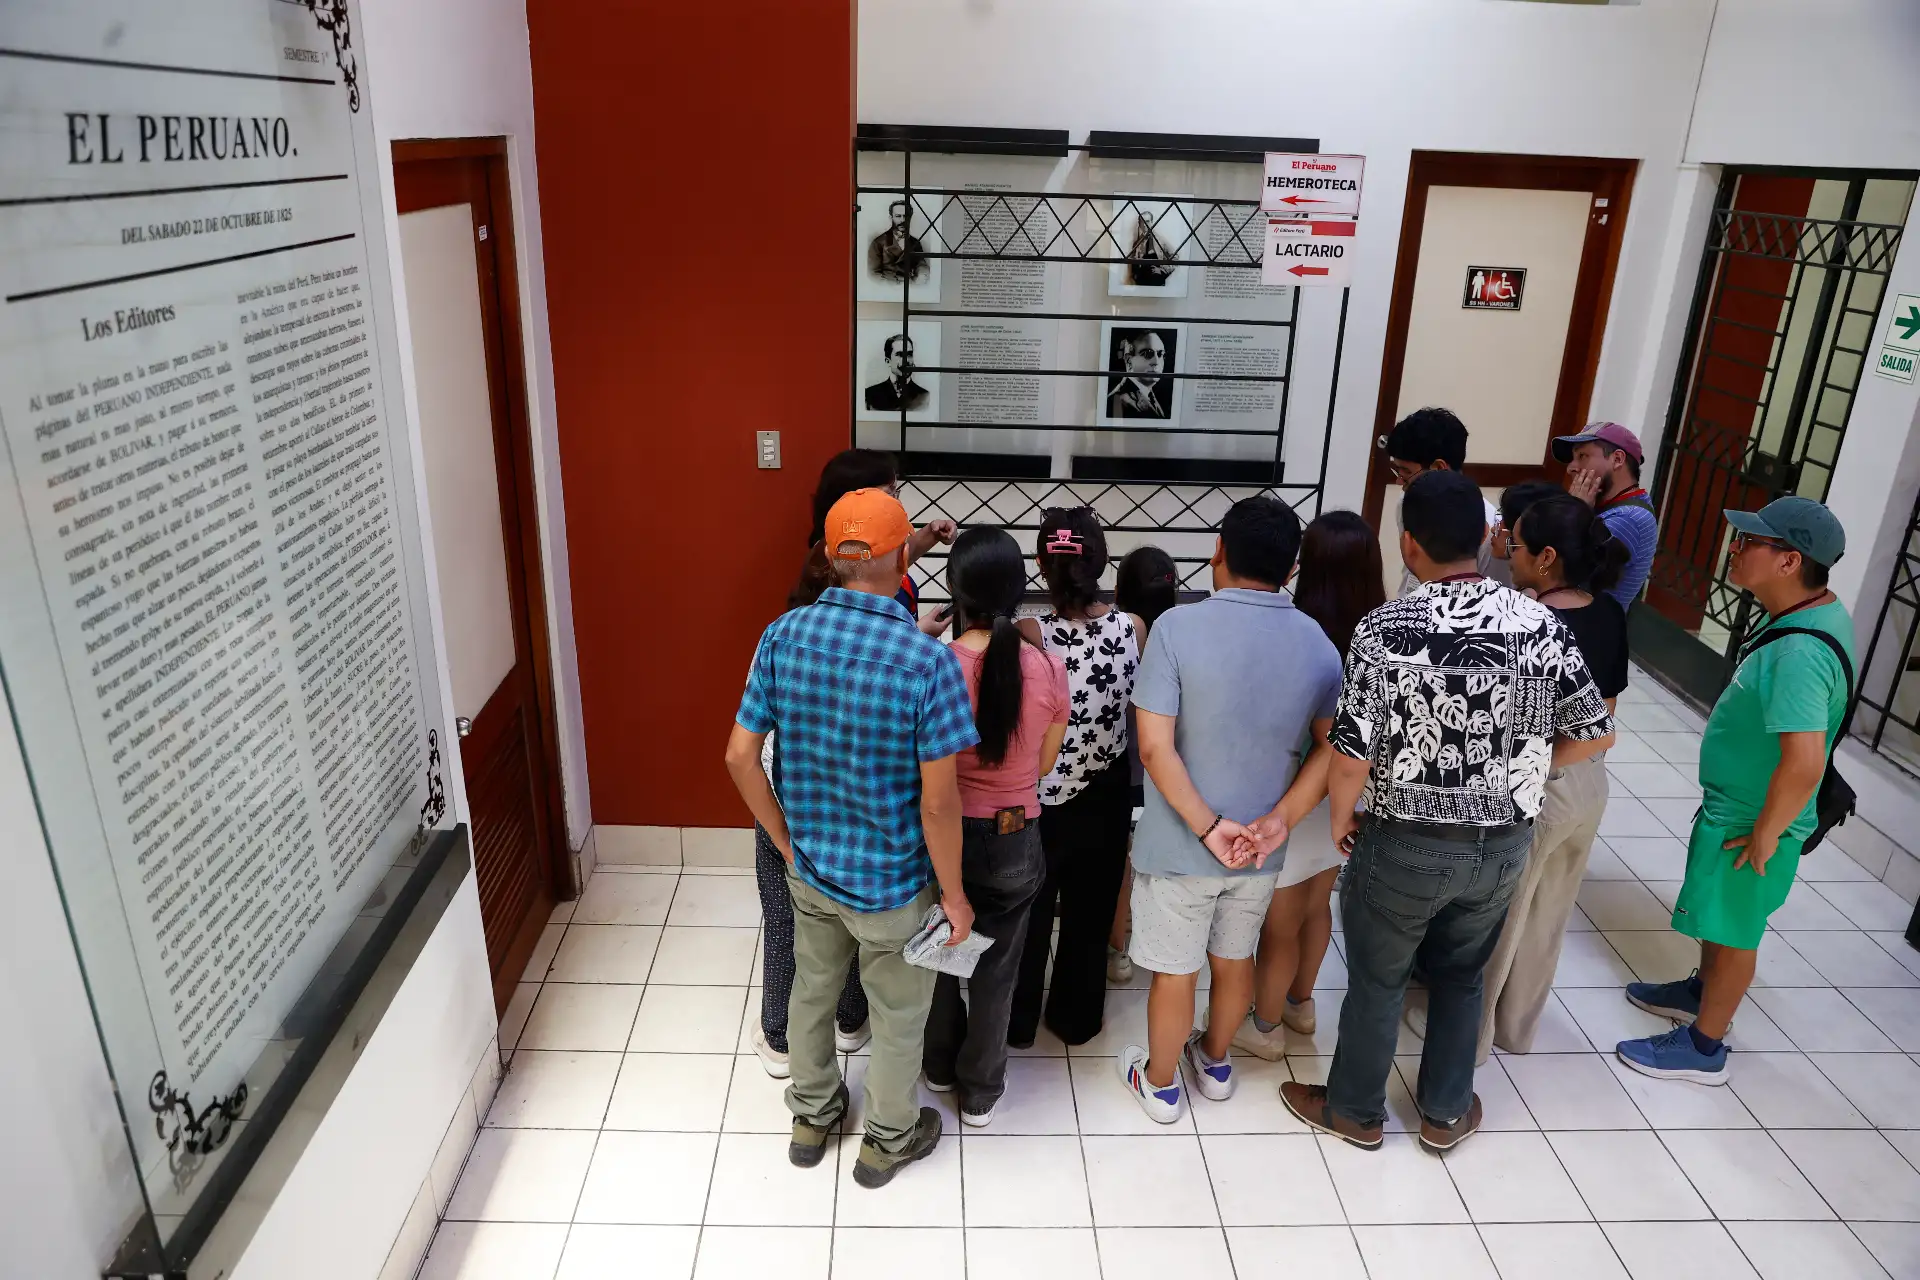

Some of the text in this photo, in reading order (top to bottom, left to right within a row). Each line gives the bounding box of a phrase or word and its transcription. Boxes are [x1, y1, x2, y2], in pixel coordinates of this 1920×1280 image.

[284, 46, 319, 64] SEMESTRE
[65, 113, 298, 165] EL PERUANO.
[1292, 161, 1337, 171] El Peruano
[1267, 176, 1356, 191] HEMEROTECA
[121, 208, 292, 245] DEL SABADO 22 DE OCTUBRE DE 1825
[1276, 244, 1344, 258] LACTARIO
[81, 304, 176, 342] Los Editores
[1881, 354, 1912, 373] SALIDA
